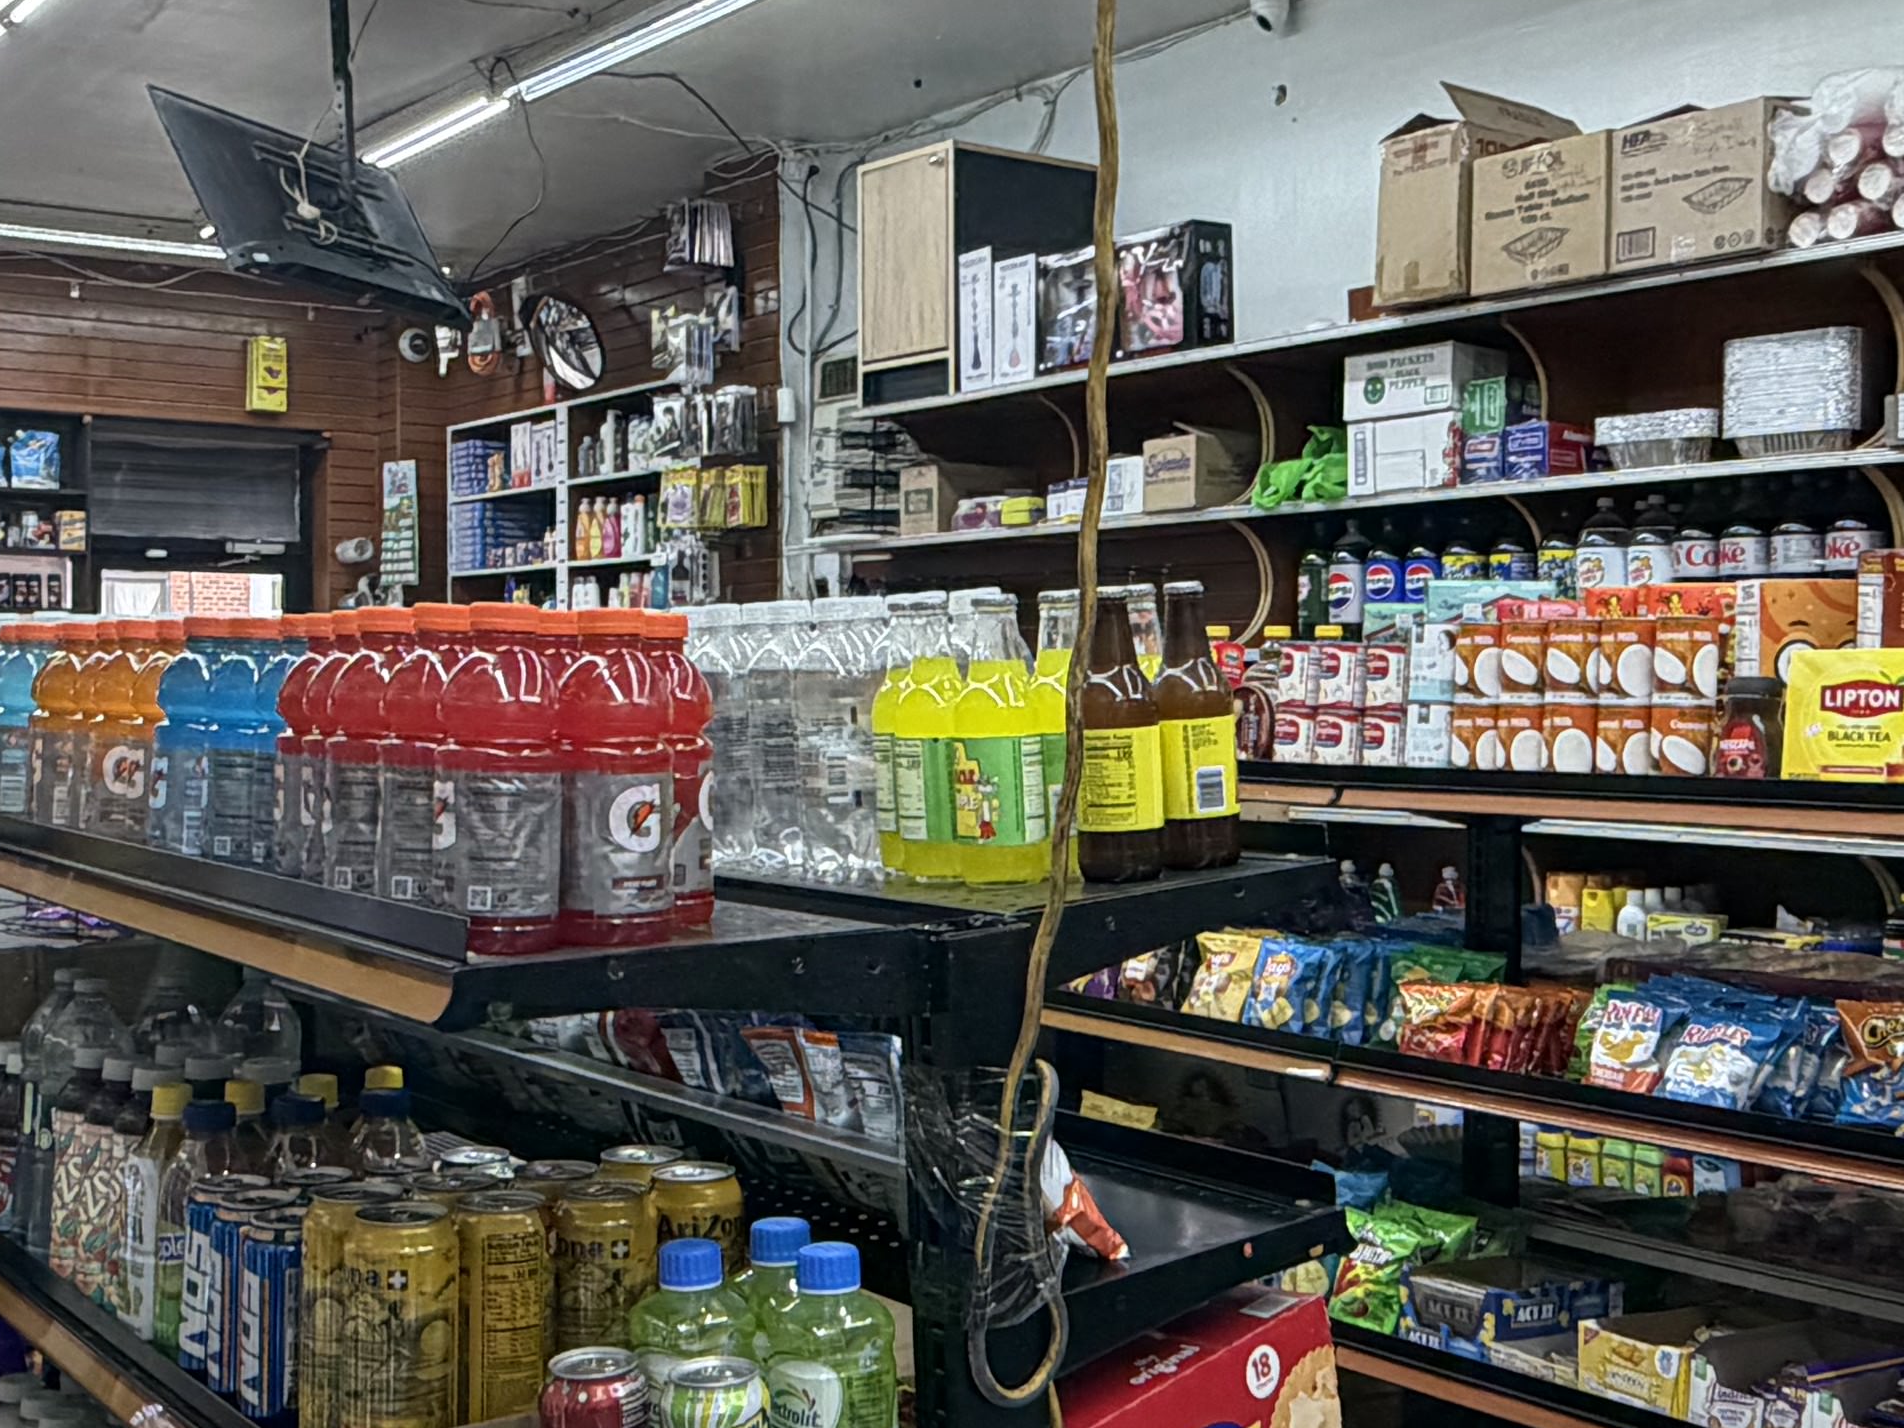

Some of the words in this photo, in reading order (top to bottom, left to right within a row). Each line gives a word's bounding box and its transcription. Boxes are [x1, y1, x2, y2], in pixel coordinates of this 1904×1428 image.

[1366, 574, 1393, 586] PEPSI
[1824, 686, 1901, 709] LIPTON
[1827, 729, 1866, 743] BLACK
[1869, 731, 1891, 744] TEA
[103, 746, 145, 798] G
[609, 783, 661, 852] G
[178, 1226, 212, 1359] NOS
[1517, 1306, 1539, 1323] ACT
[240, 1268, 261, 1407] NOS
[1128, 1344, 1200, 1387] original
[1250, 1351, 1272, 1382] 18
